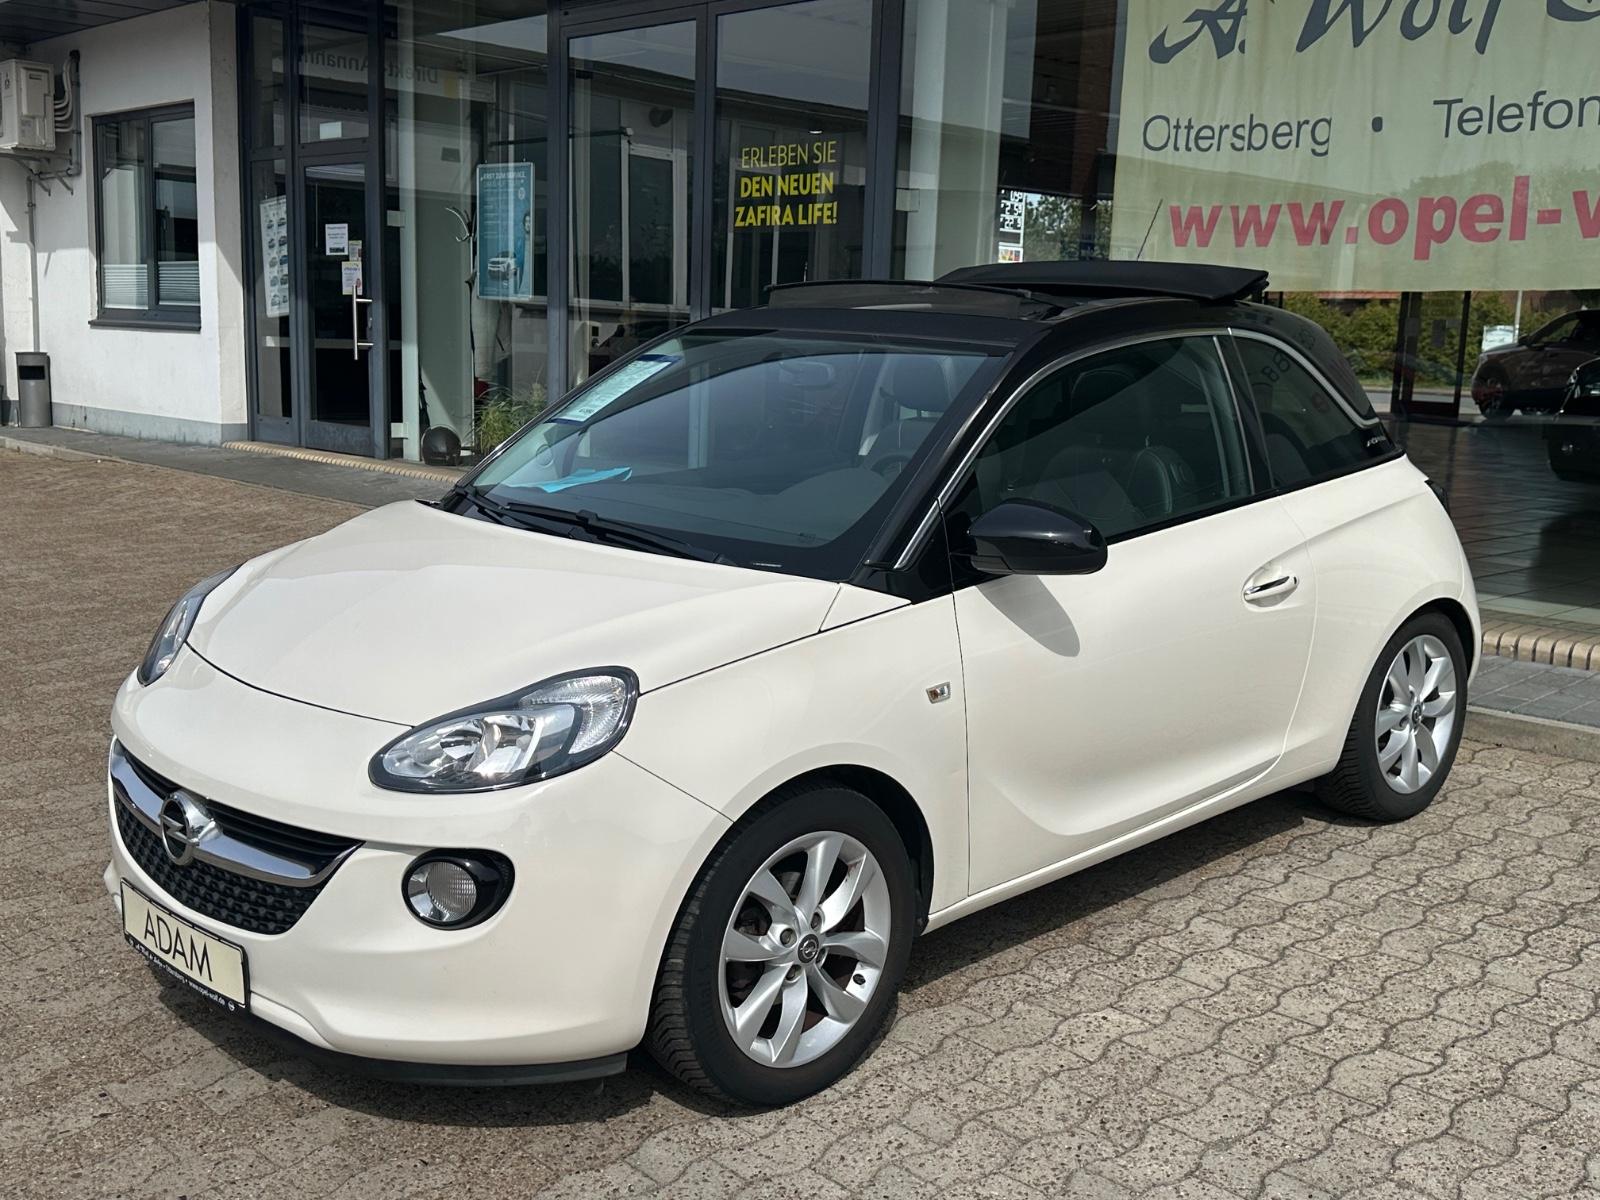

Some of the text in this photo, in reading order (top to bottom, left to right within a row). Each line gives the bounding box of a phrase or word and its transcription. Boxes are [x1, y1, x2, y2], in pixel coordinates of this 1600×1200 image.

[1142, 90, 1600, 157] Ottersberg Telefon
[741, 140, 837, 169] ERLEBEN SIE
[740, 172, 834, 198] DEN NEUEN
[734, 201, 838, 228] ZAFIRA LIFE!
[143, 908, 213, 983] ADAM
